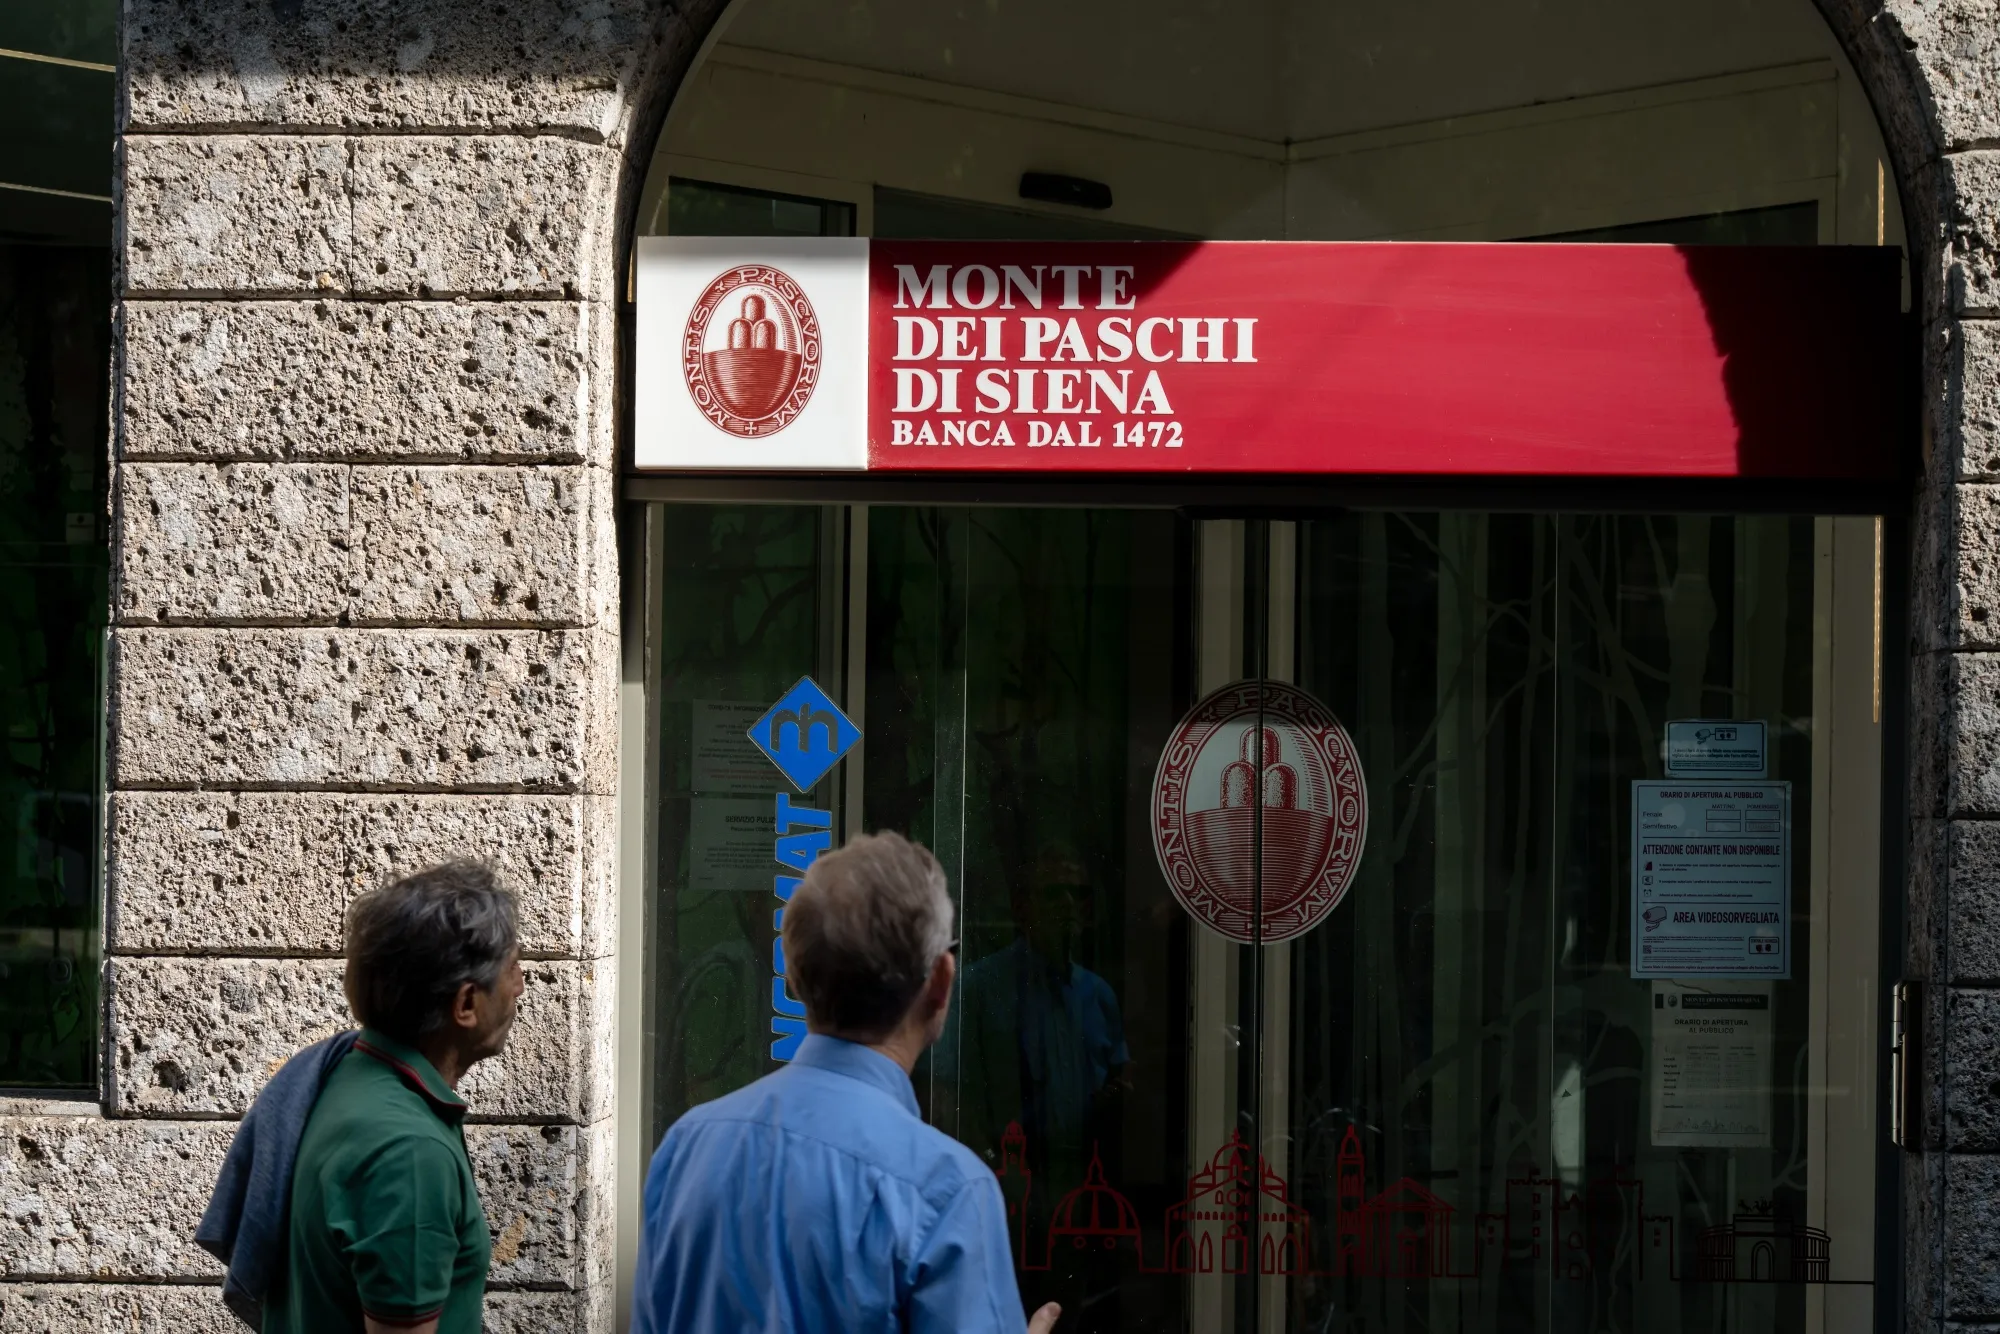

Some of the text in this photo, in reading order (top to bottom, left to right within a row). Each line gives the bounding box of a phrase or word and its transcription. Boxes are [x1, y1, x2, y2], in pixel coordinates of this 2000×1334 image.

[892, 264, 1137, 310] MONTE
[891, 315, 1259, 363] DEI PASCHI
[685, 304, 730, 427] MONTIS
[891, 367, 1176, 415] DI SIENA
[890, 419, 1184, 448] BANCA DAL 1472
[1660, 791, 1764, 799] ORARIO DI APERTURA AL PUBBLICO
[1160, 740, 1226, 924] MONTIS
[1642, 823, 1678, 831] Semifestivo
[1642, 844, 1780, 856] ATTENZIONE CONTANTE NON DISPONIBILE
[1673, 911, 1781, 924] AREA VIDEOSORVEGLIATA
[1674, 1018, 1701, 1026] ORARIO
[1711, 1019, 1749, 1027] APERTURA
